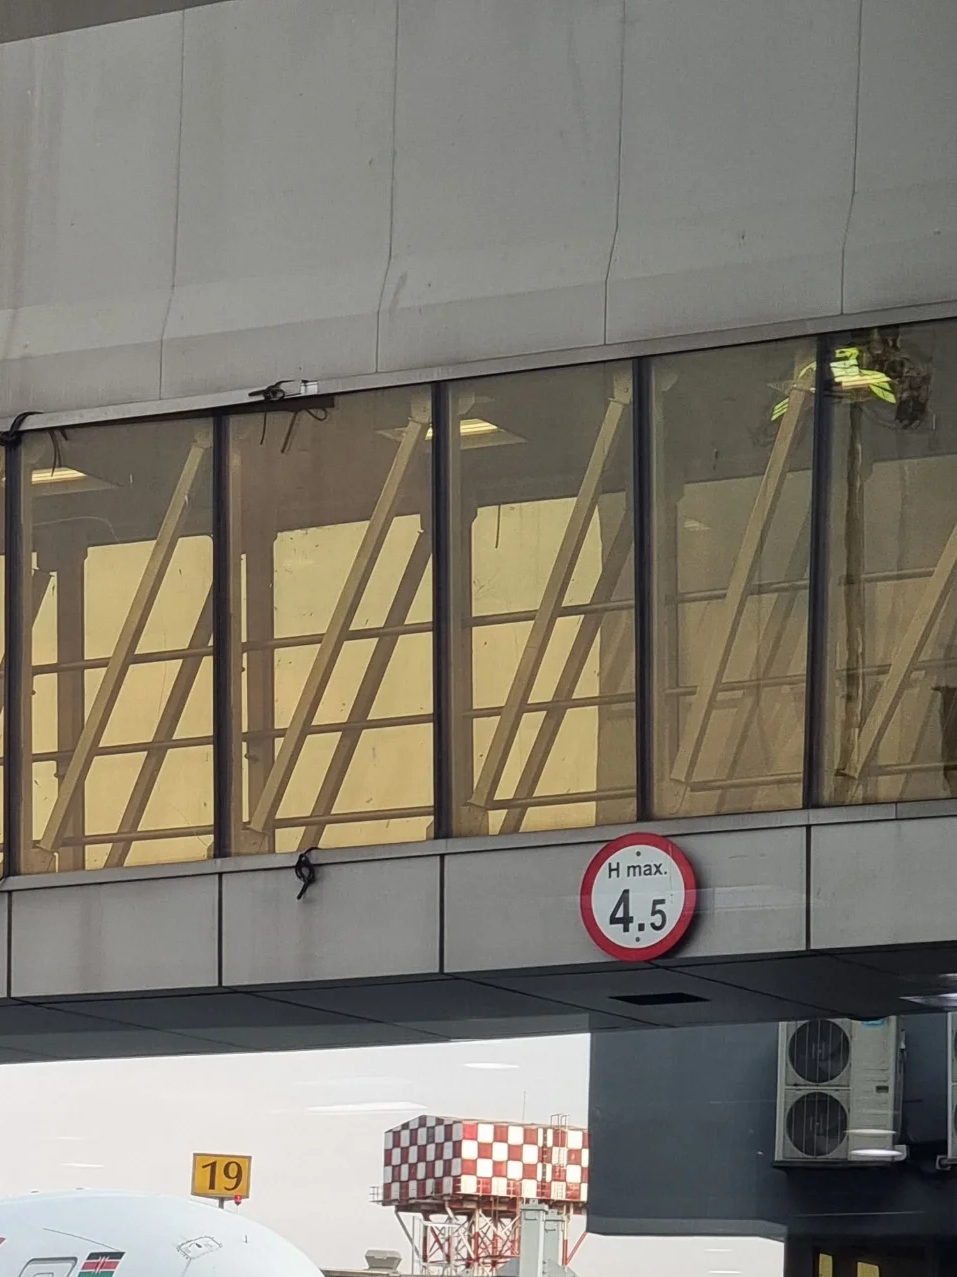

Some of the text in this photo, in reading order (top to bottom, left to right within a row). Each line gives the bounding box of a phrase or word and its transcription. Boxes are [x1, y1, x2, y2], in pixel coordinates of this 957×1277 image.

[608, 862, 668, 879] H max.
[609, 888, 667, 933] 4.5
[201, 1160, 243, 1191] 19
